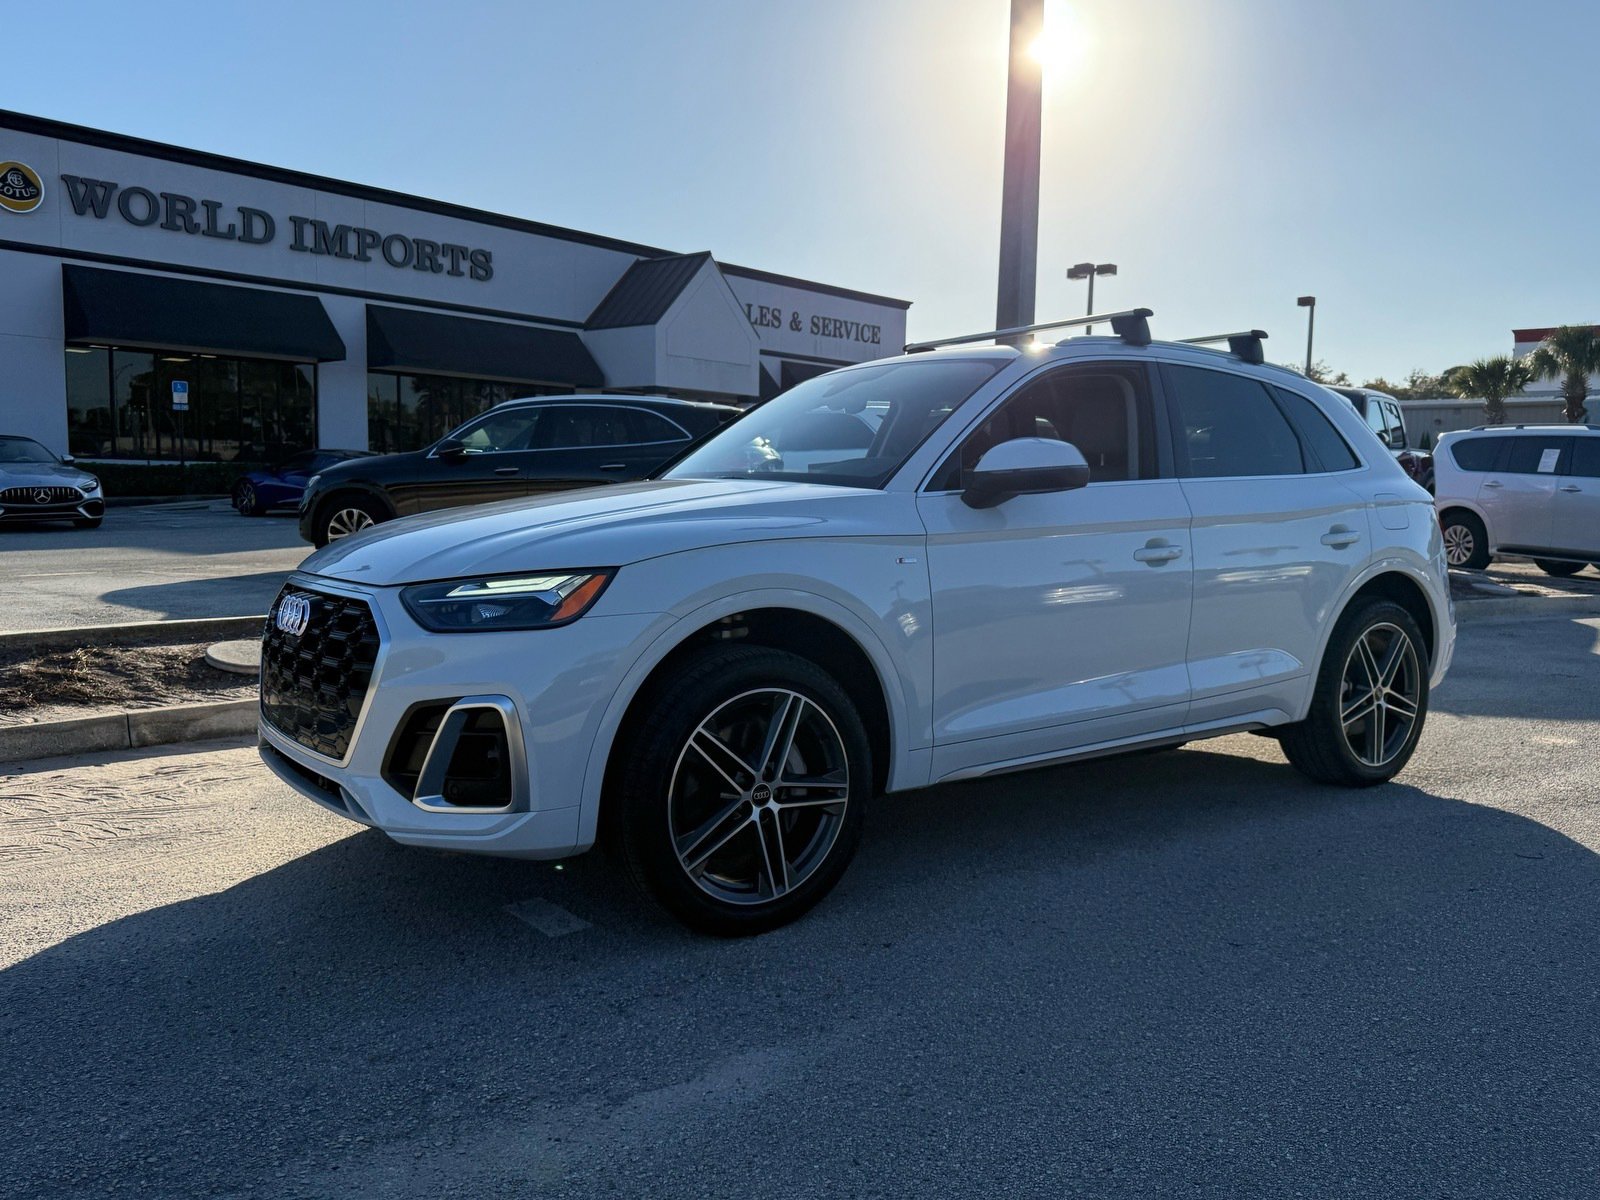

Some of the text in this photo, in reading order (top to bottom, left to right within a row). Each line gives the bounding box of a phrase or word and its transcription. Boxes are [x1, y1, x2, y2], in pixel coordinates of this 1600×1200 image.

[0, 184, 37, 197] OTUS
[61, 174, 494, 282] WORLD IMPORTS
[789, 311, 802, 332] &
[810, 315, 881, 345] SERVICE
